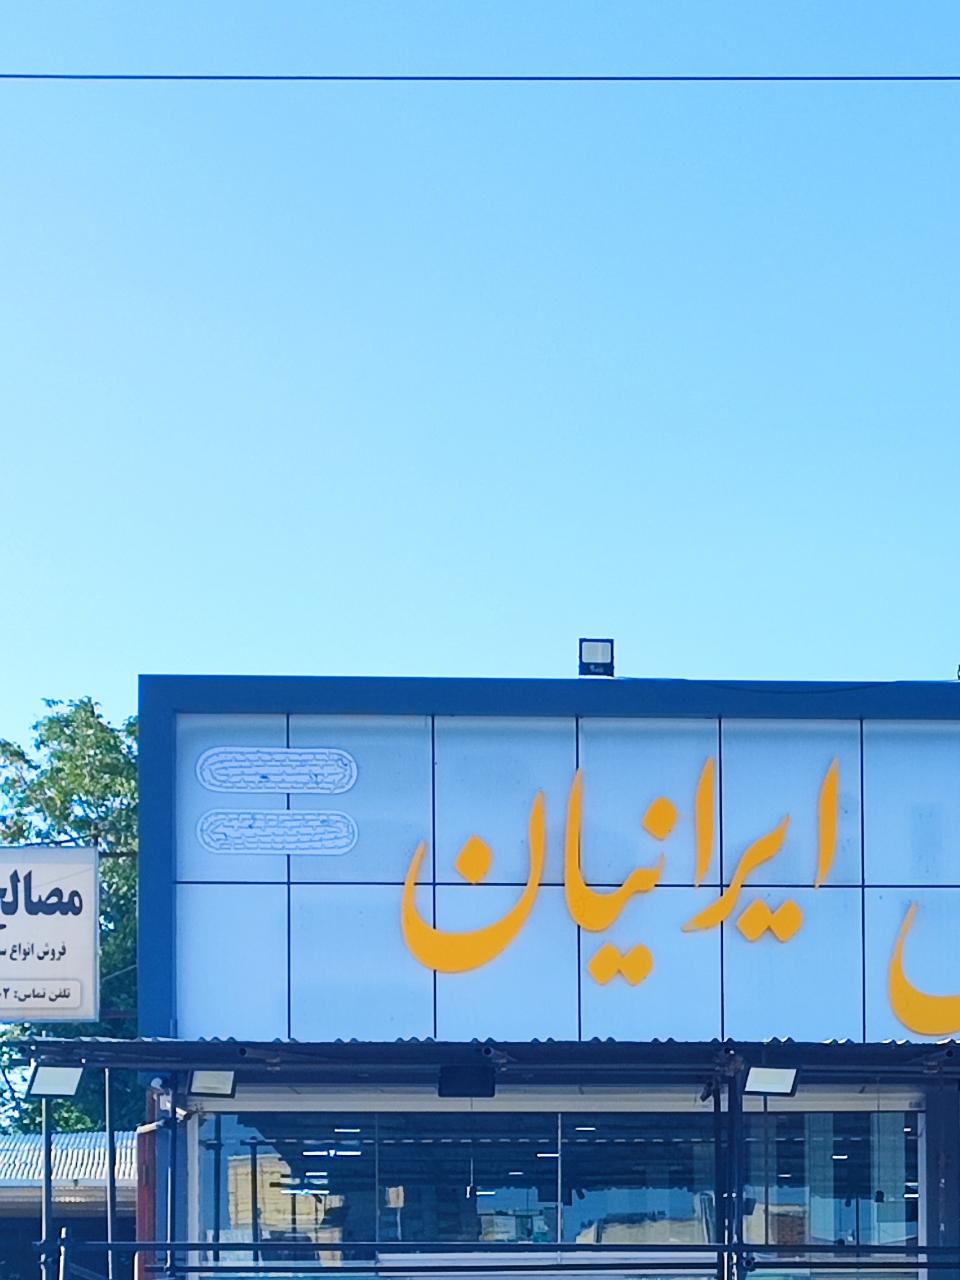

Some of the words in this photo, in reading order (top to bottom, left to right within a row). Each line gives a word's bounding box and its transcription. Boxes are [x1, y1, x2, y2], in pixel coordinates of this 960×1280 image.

[401, 757, 839, 985] ایرانیان
[9, 942, 35, 961] انواع
[37, 941, 67, 961] فروش
[48, 988, 71, 1002] تلفن
